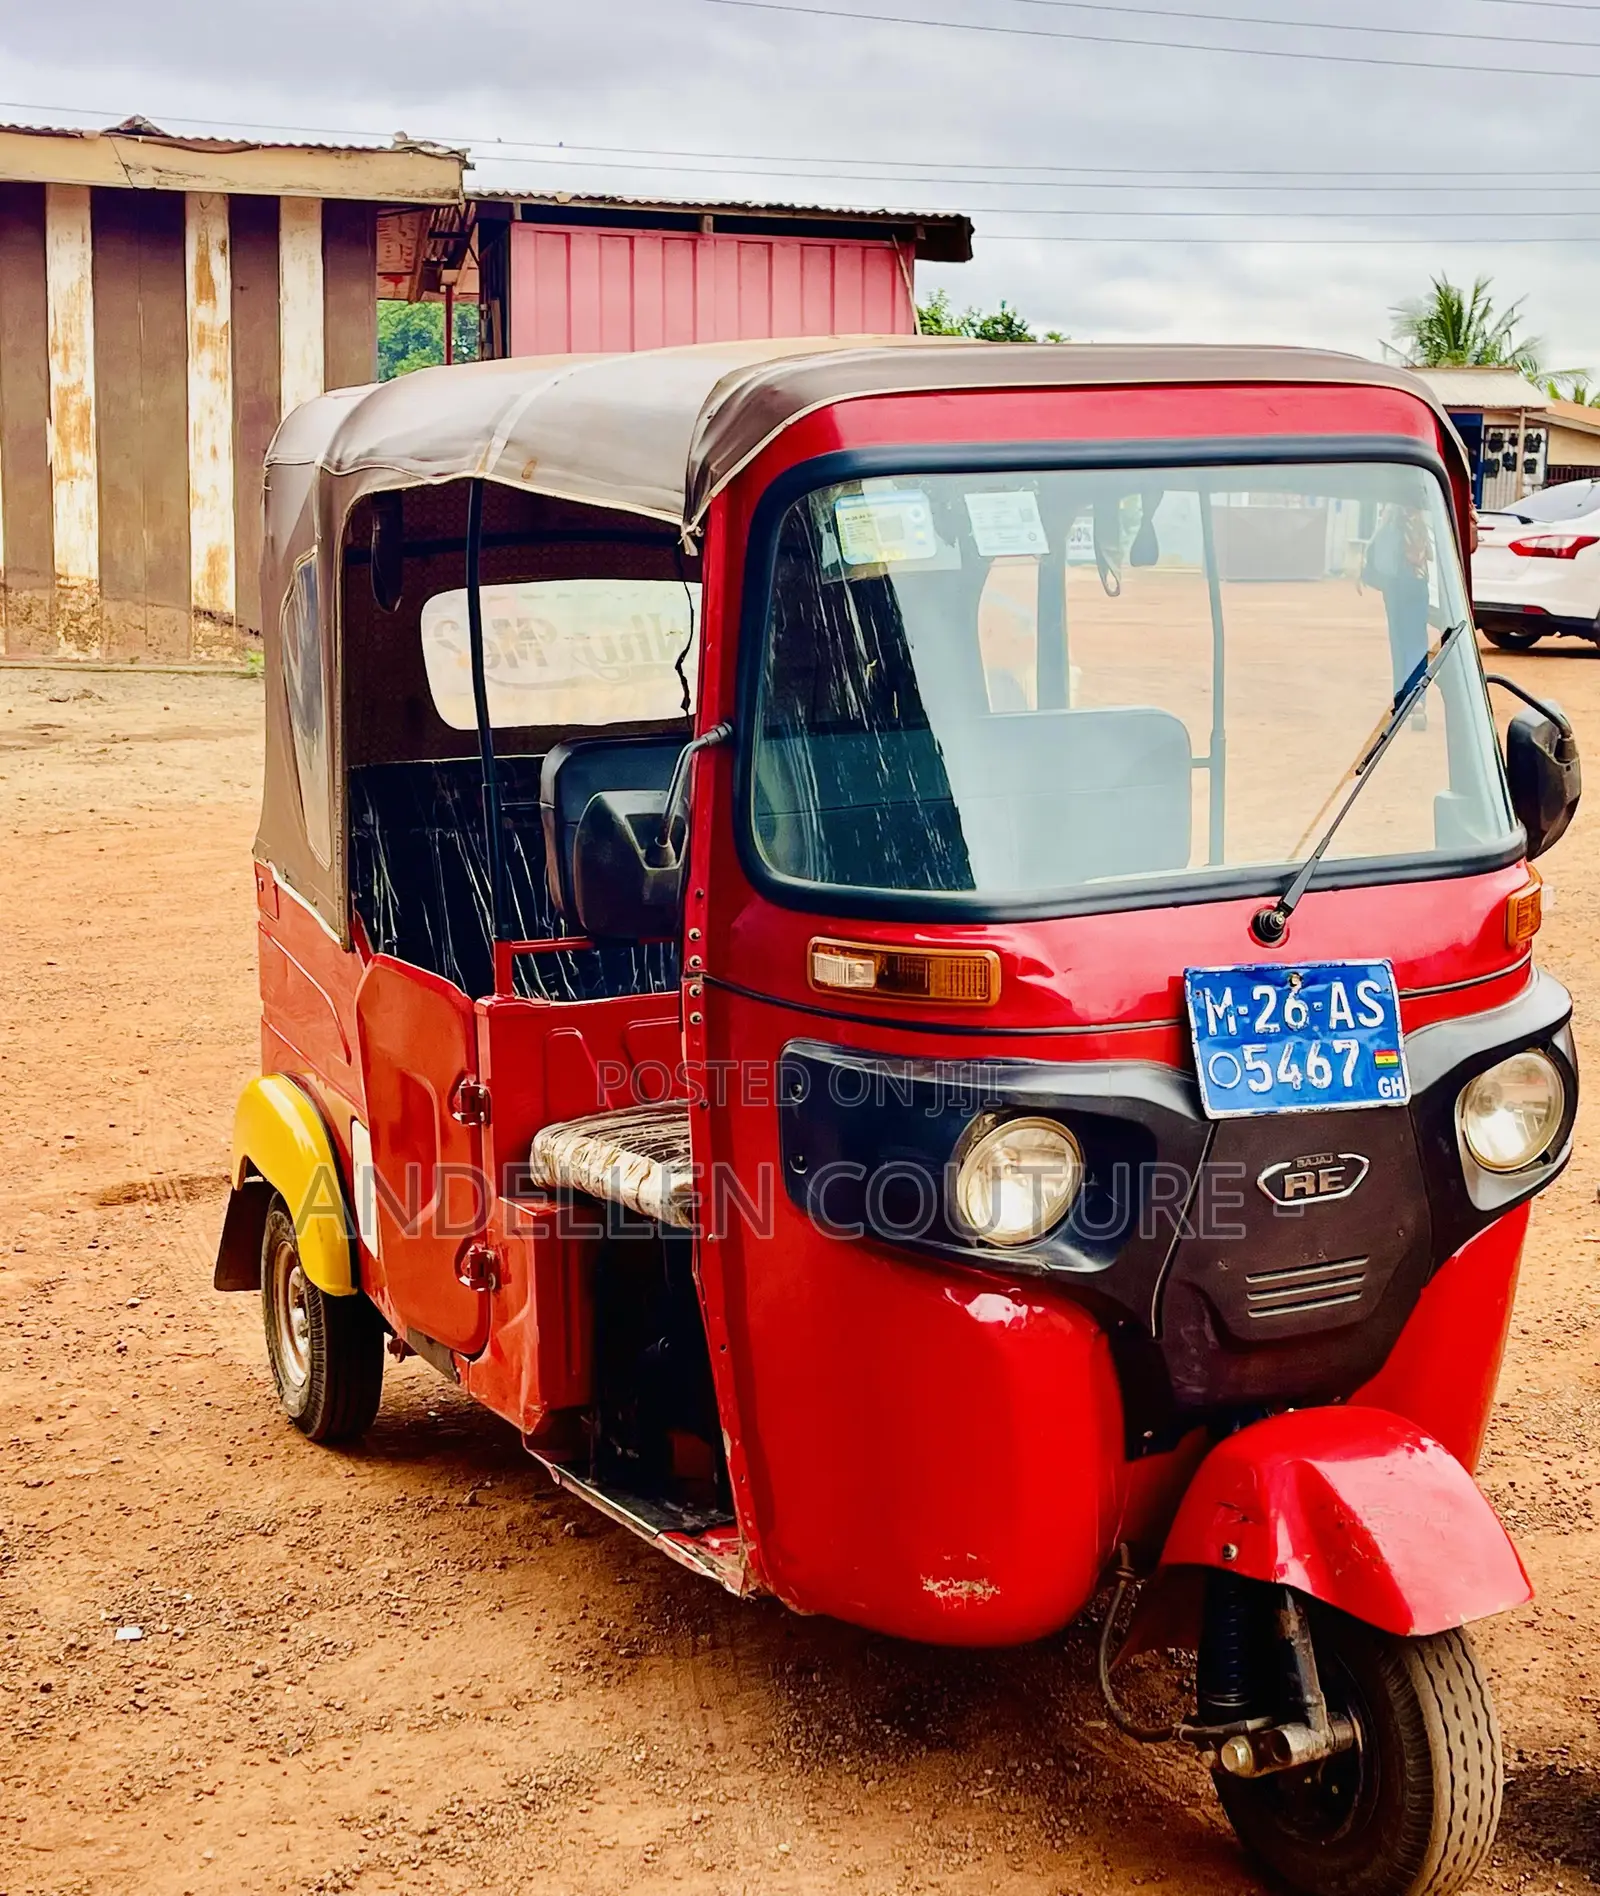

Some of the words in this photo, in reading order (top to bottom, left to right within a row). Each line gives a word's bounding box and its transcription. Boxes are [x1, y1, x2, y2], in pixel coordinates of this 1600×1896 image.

[1203, 980, 1385, 1036] M-26-AS
[1242, 1039, 1360, 1093] 5467
[1377, 1076, 1405, 1098] GH
[1296, 1155, 1334, 1168] BAJAJ
[1284, 1167, 1346, 1198] RE
